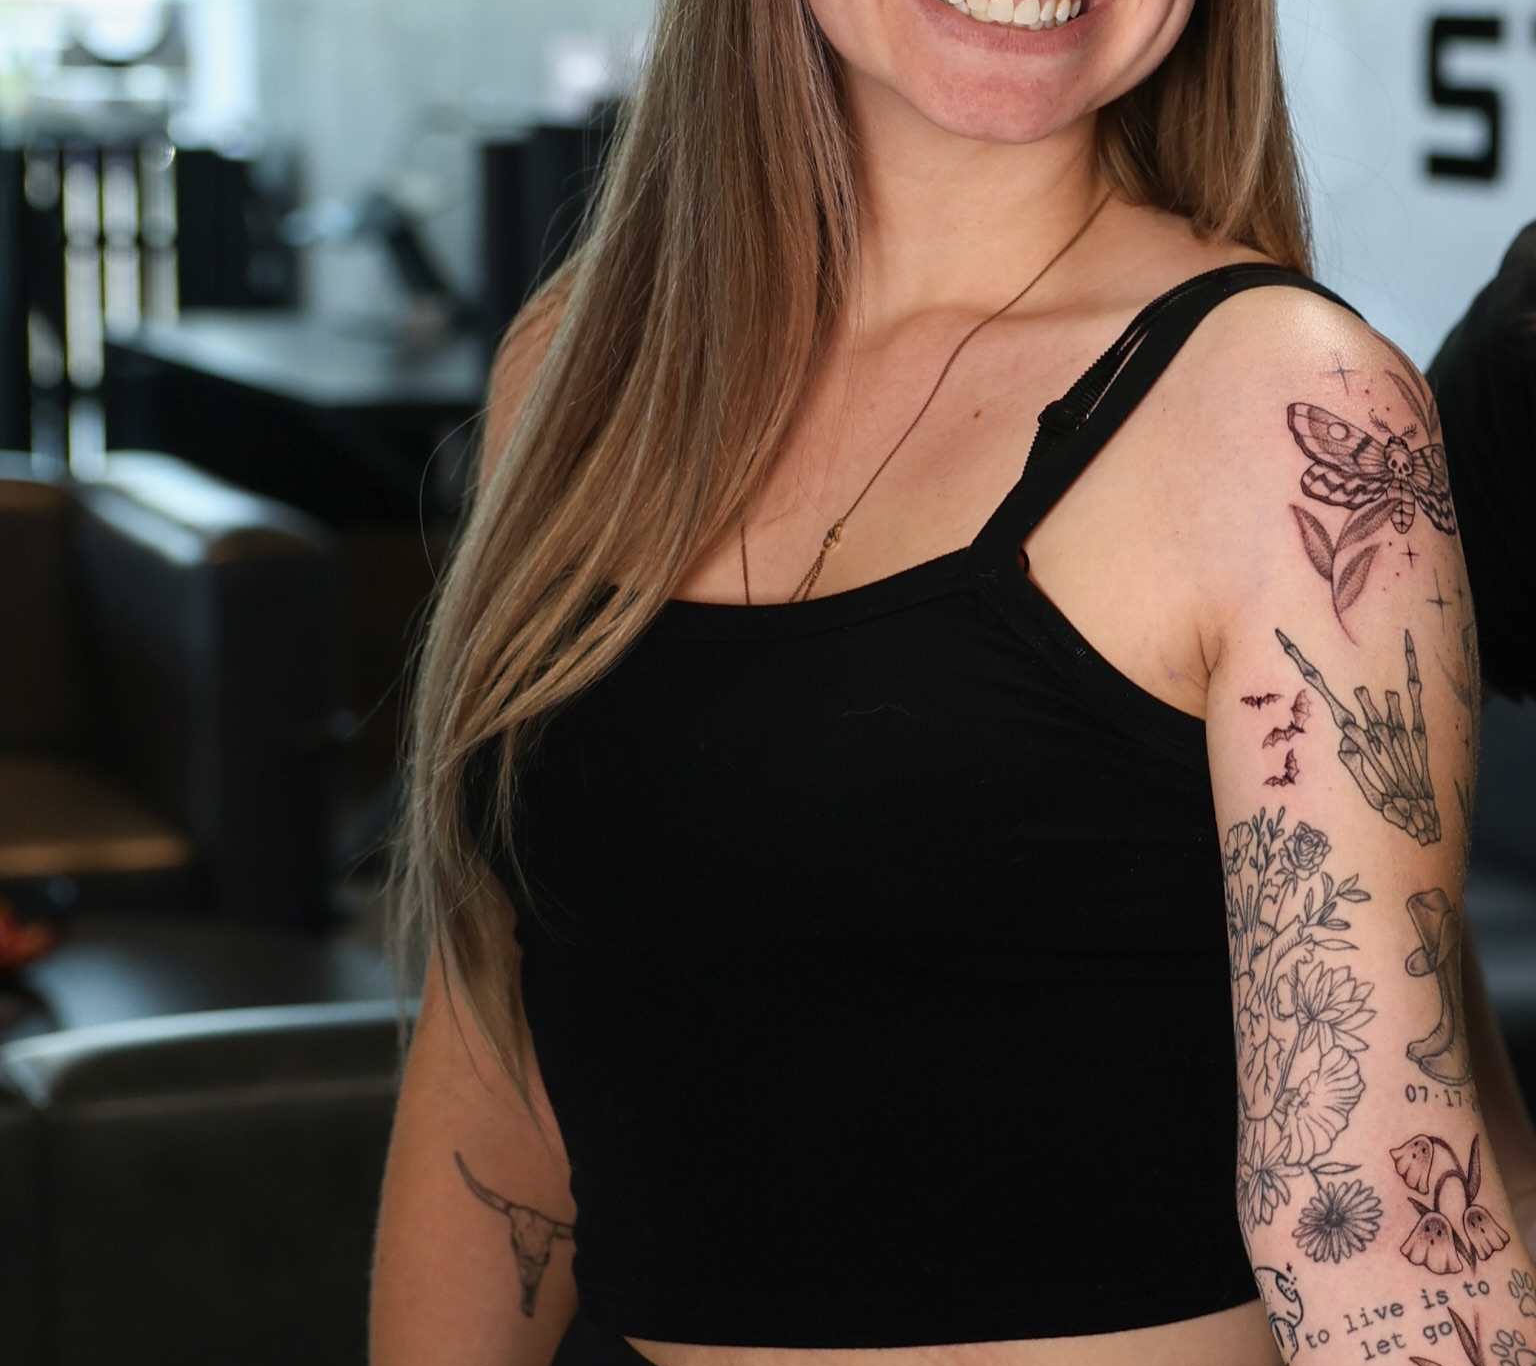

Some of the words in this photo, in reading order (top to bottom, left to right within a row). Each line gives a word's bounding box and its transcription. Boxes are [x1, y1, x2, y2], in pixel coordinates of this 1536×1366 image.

[1305, 1328, 1330, 1350] to
[1343, 1302, 1405, 1335] live
[1420, 1287, 1449, 1310] is
[1462, 1280, 1491, 1298] to
[1361, 1332, 1407, 1361] let
[1422, 1320, 1453, 1346] go
